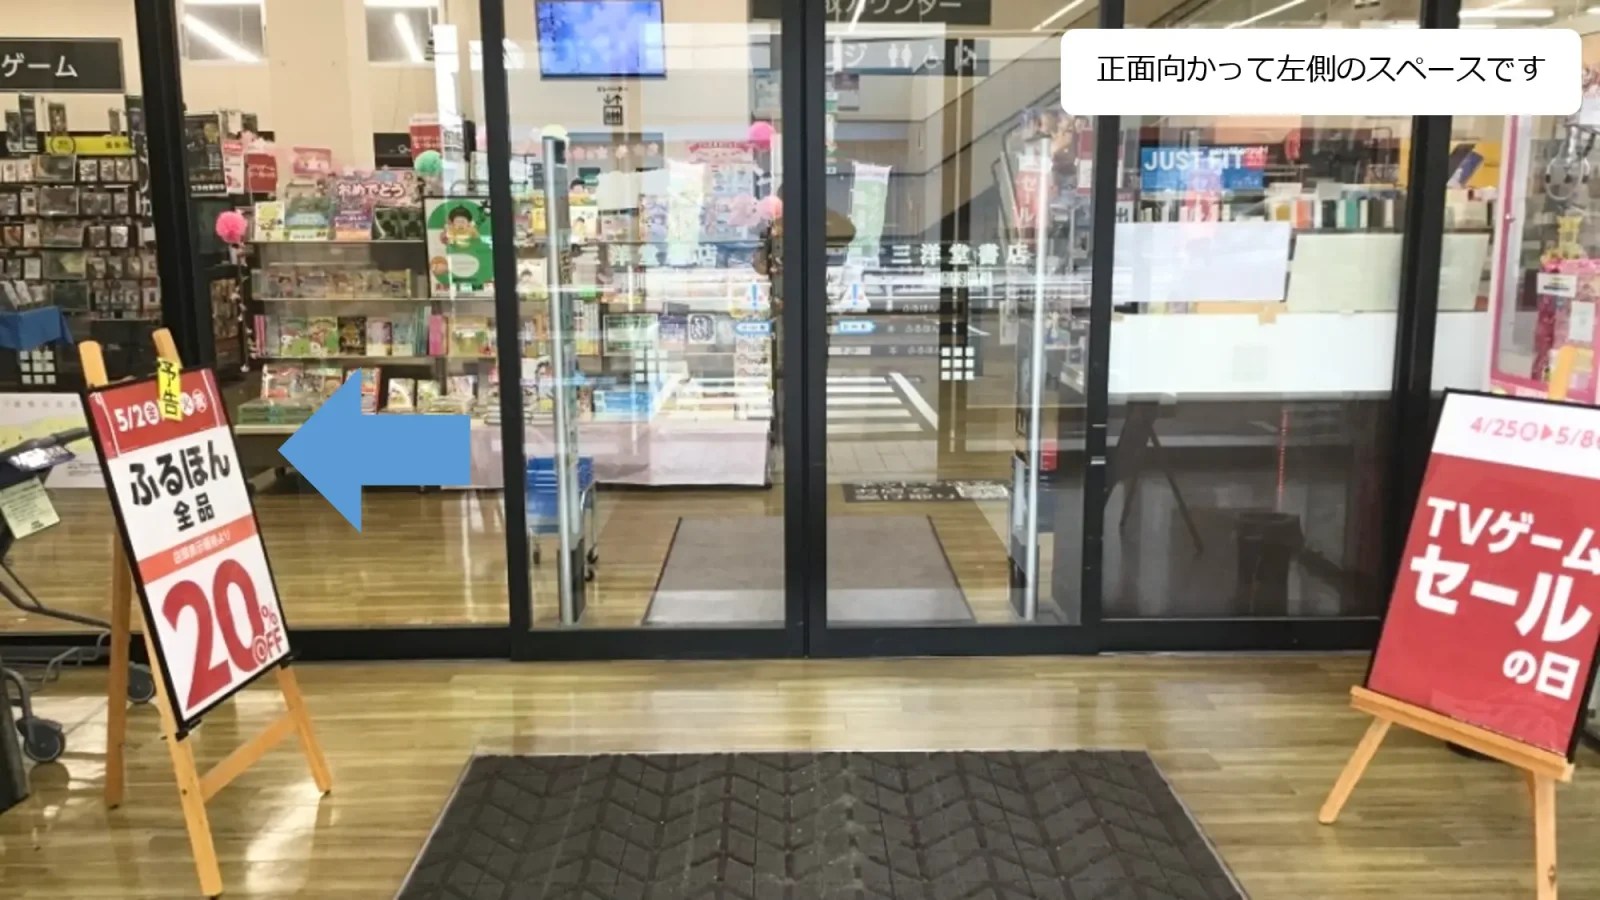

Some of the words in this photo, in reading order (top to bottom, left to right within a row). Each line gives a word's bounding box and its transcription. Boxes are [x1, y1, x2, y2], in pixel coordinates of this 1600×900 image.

[1, 54, 78, 78] ゲーム
[1144, 149, 1203, 171] JUST
[891, 243, 1030, 265] 三洋堂書店
[129, 440, 231, 506] ふるほん
[173, 492, 215, 532] 全品
[1410, 544, 1593, 642] セール
[1502, 649, 1580, 700] の日
